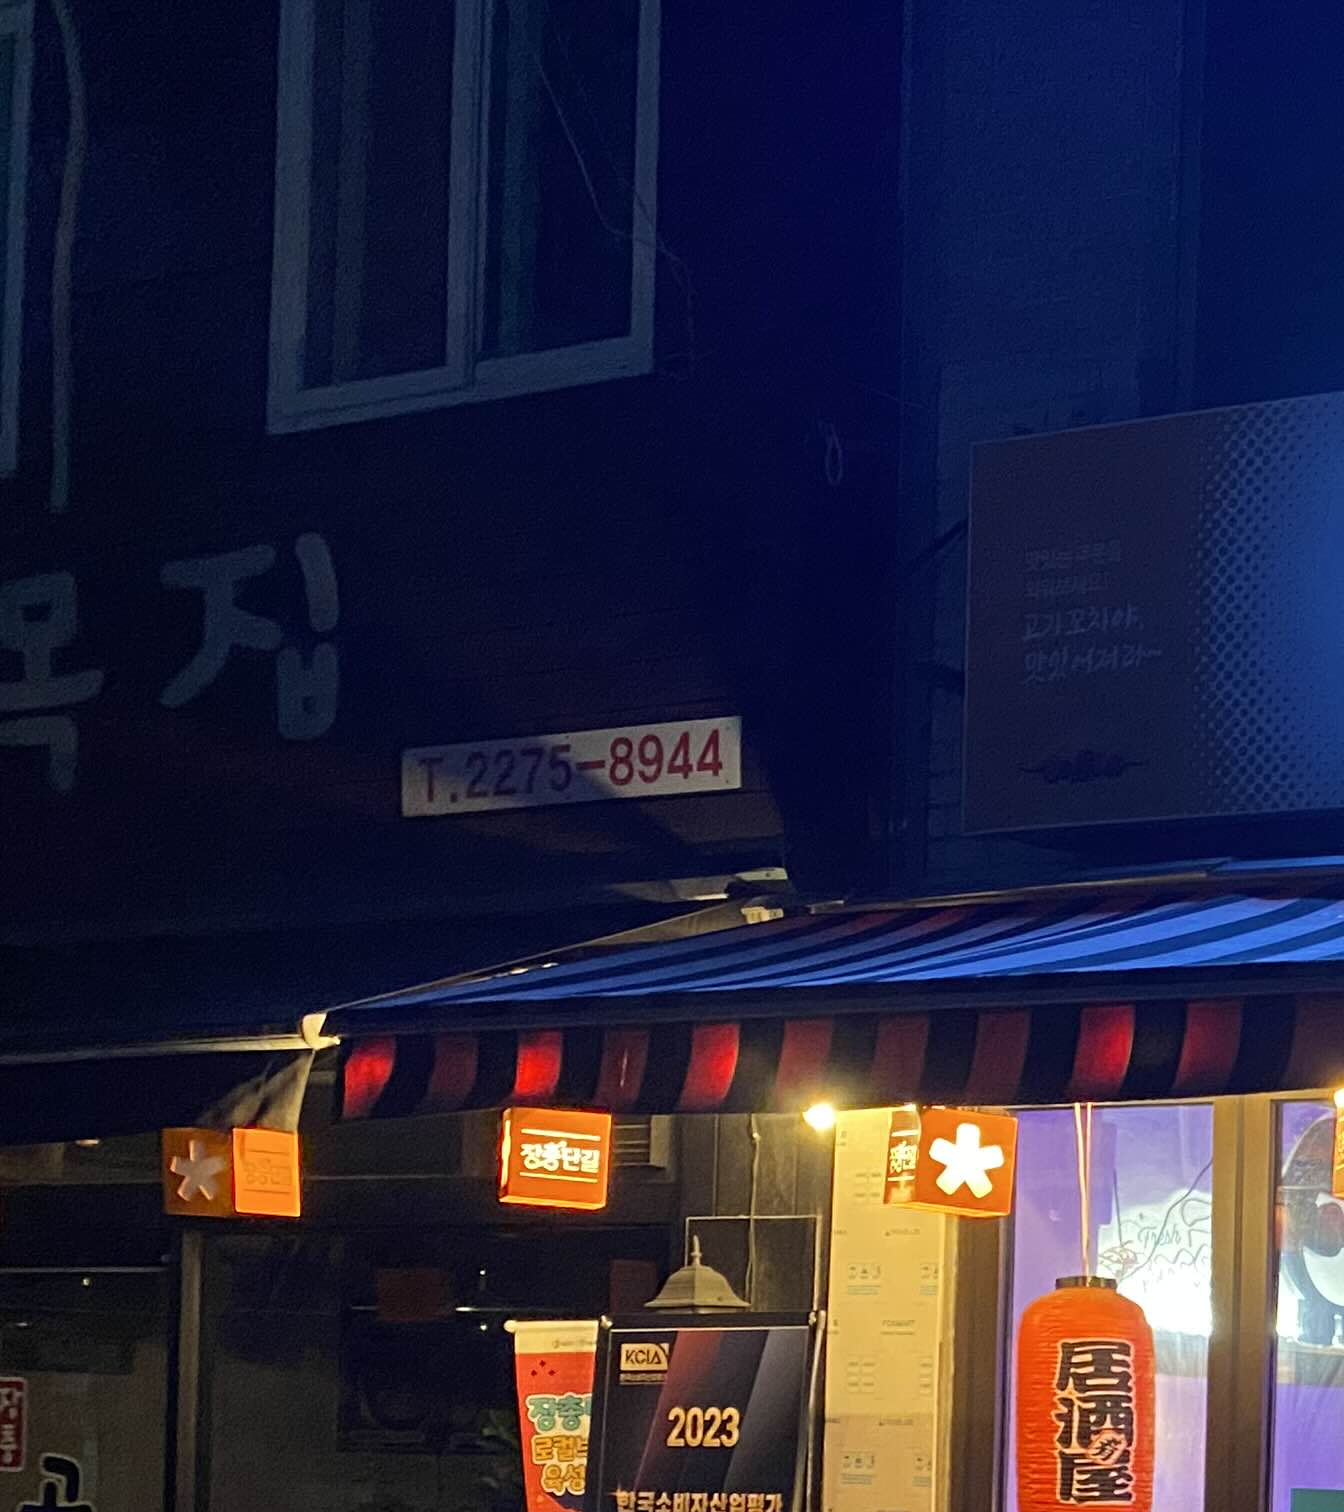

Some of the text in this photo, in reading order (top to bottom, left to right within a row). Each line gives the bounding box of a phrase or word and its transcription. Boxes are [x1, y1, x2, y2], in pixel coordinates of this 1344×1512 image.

[520, 1140, 600, 1173] 장충단길
[623, 1348, 662, 1366] KCIA
[667, 1406, 741, 1448] 2023
[1055, 1339, 1135, 1504] 居酒屋
